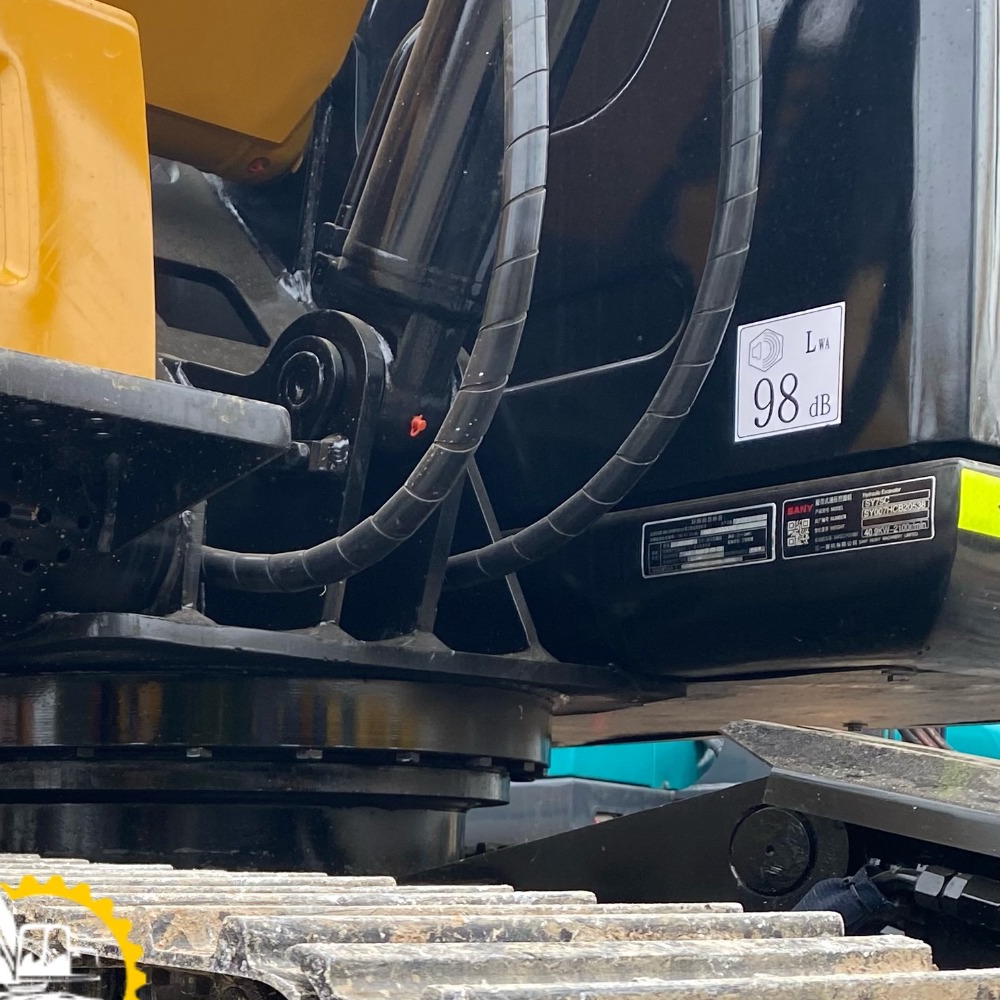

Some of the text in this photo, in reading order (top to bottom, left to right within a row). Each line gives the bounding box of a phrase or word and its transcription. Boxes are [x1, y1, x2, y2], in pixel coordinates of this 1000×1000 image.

[753, 372, 831, 428] 98 dB
[864, 496, 891, 508] SY75C
[787, 503, 814, 516] SANY
